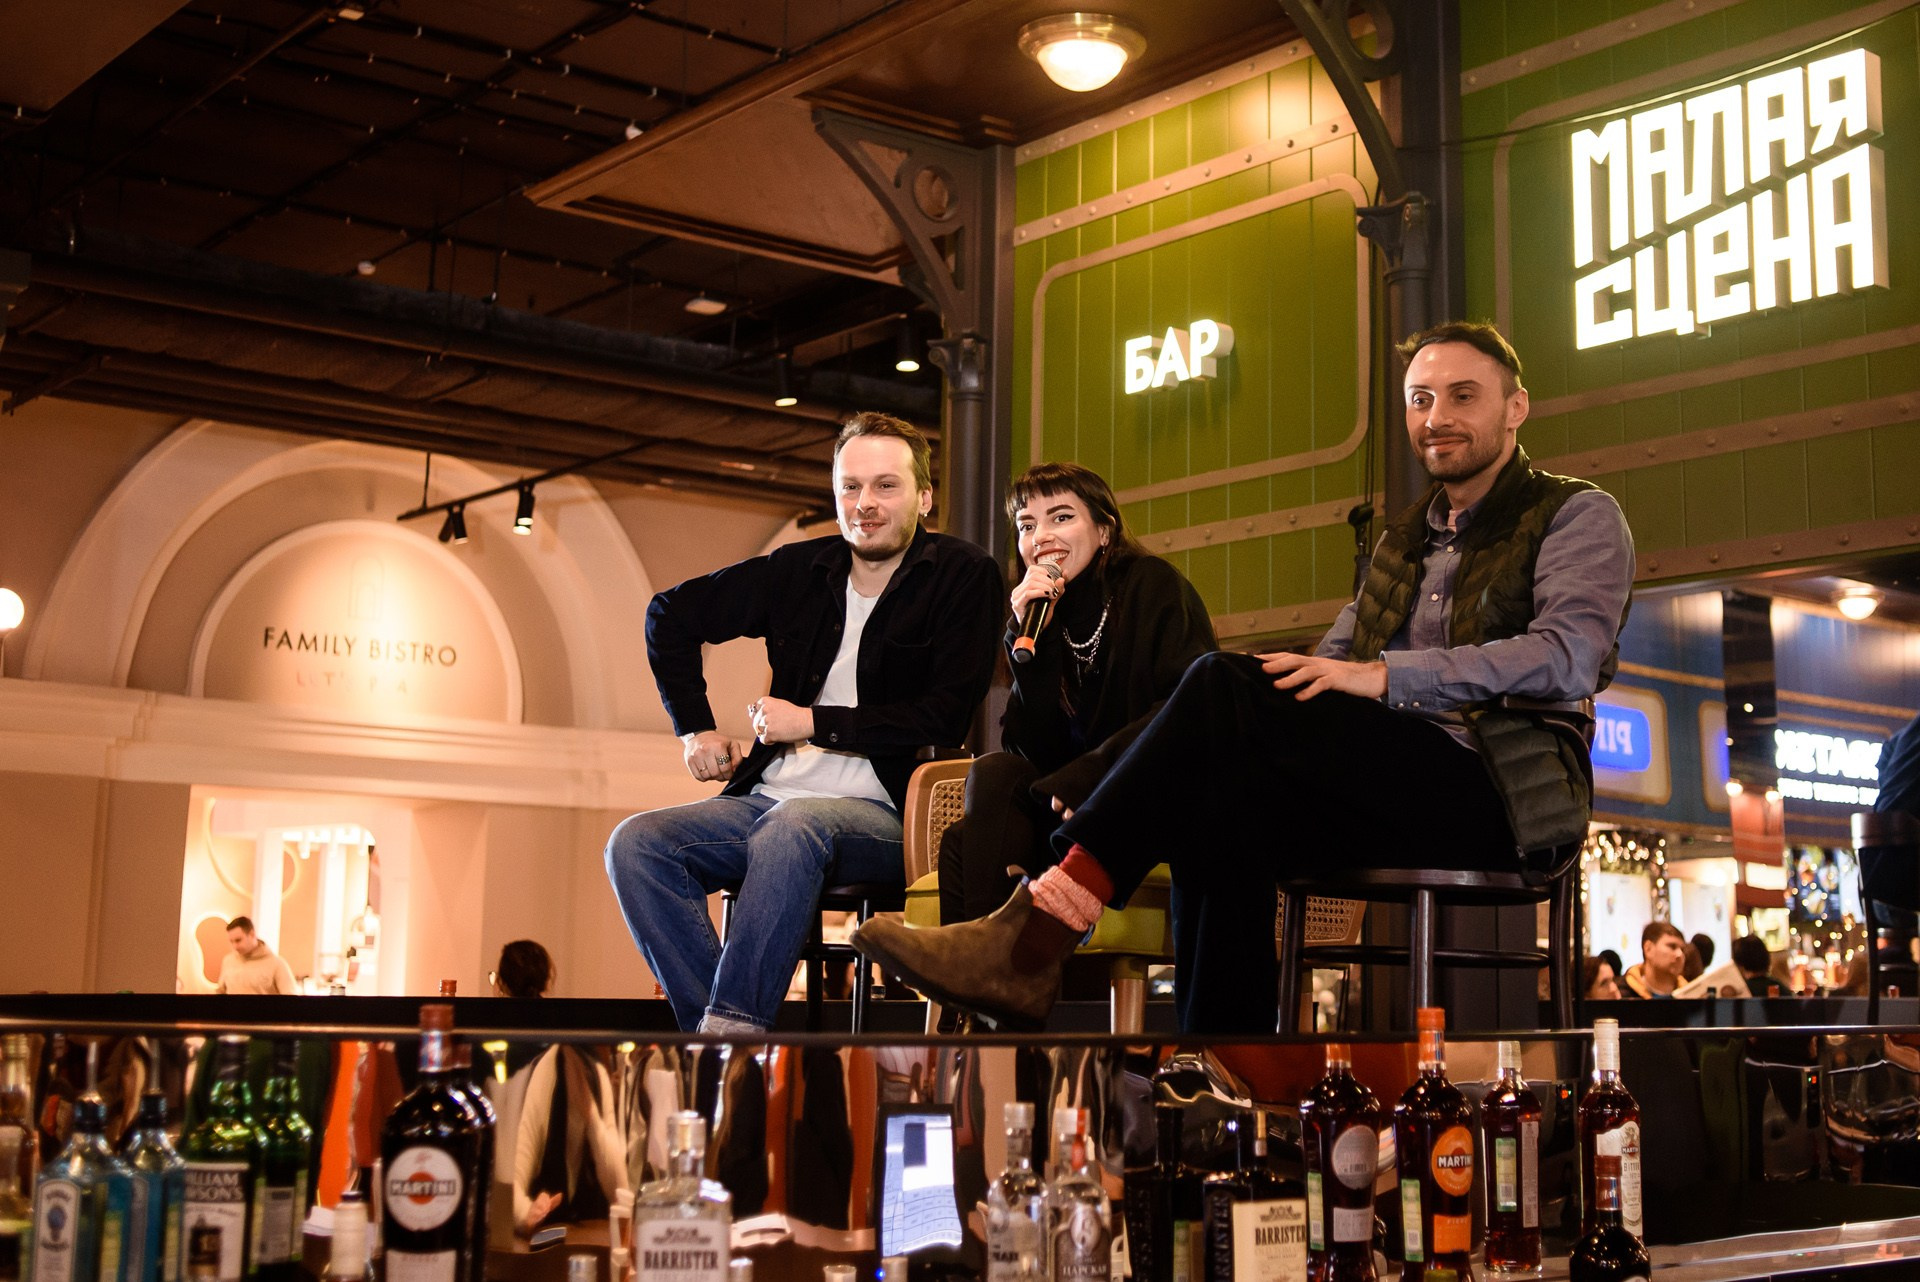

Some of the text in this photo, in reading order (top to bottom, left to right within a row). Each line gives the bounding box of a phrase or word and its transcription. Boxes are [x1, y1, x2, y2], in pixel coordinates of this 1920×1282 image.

[1572, 48, 1868, 268] МАЛАЯ
[1125, 318, 1220, 394] БАР
[264, 627, 457, 667] FAMILY BISTRO
[1438, 1155, 1473, 1168] MARTIN
[391, 1180, 456, 1196] MARTINI
[1255, 1225, 1306, 1245] BARRISTER
[644, 1251, 718, 1270] BARRISTER
